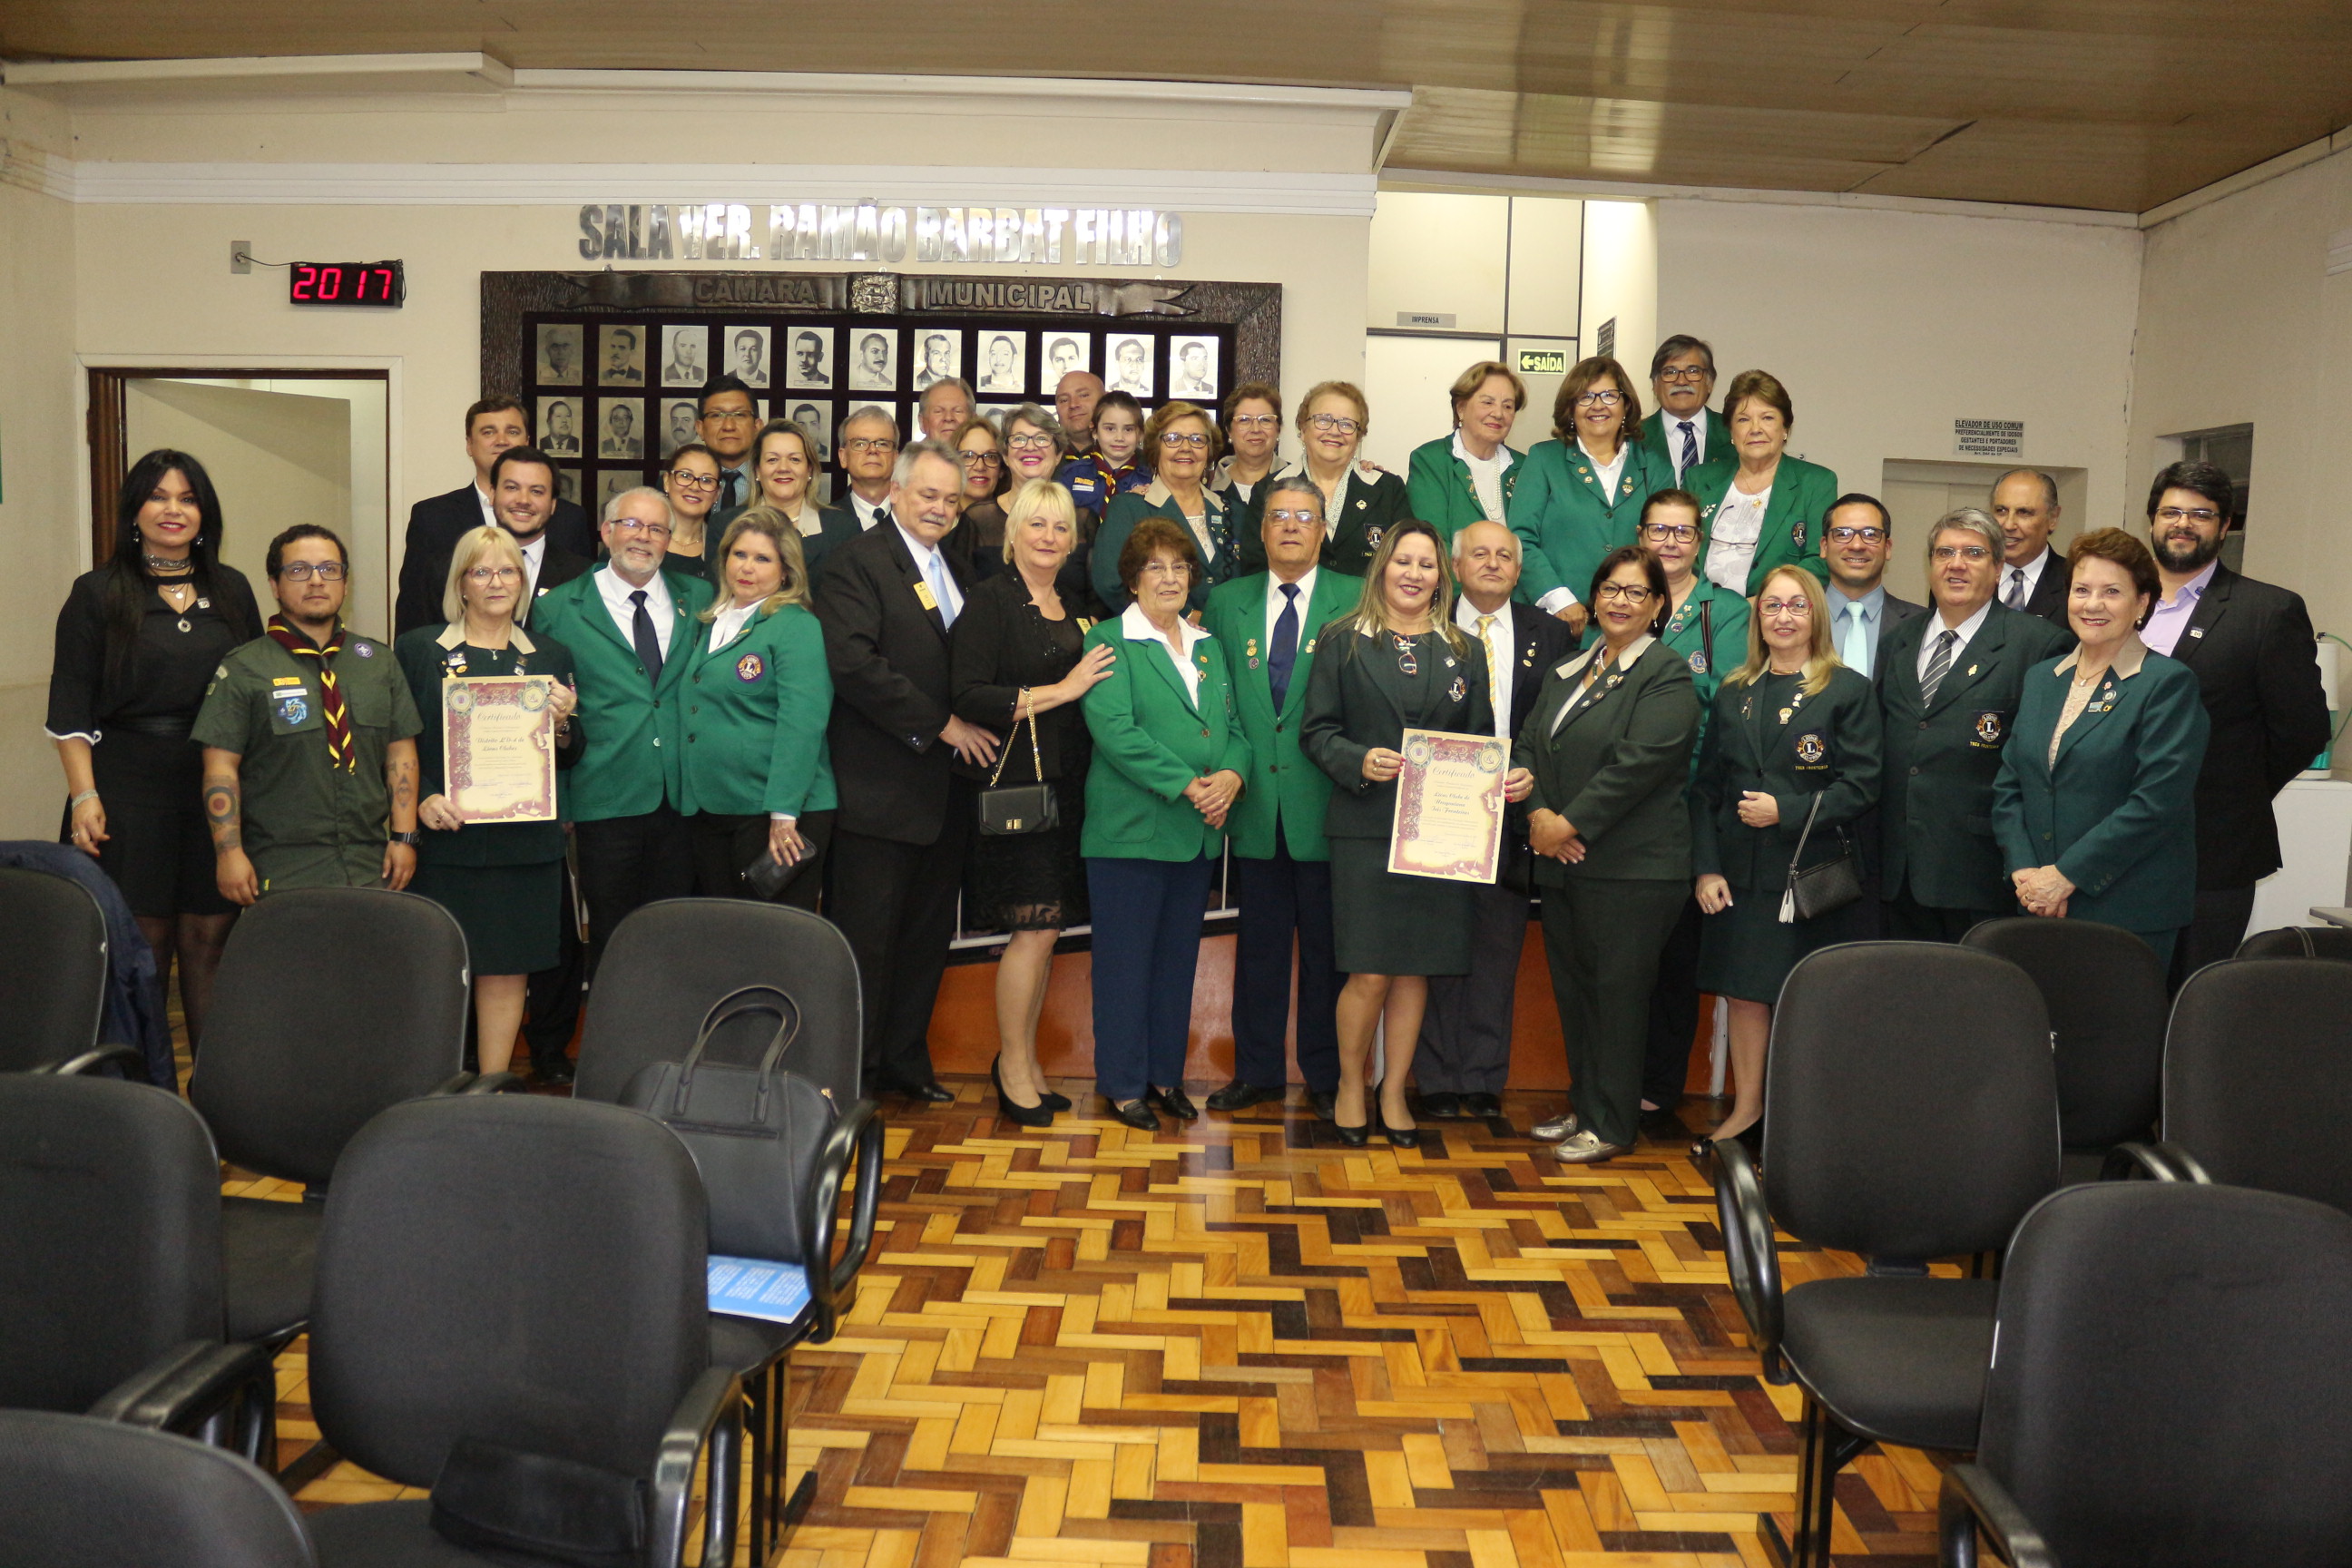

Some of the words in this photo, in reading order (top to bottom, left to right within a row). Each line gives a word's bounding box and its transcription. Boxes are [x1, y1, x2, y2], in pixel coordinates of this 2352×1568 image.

[578, 204, 674, 260] SALA
[679, 203, 760, 260] VER.
[916, 206, 1069, 263] BARBAT
[1075, 209, 1181, 268] FILHO
[929, 282, 1092, 311] MUNICIPAL
[1411, 316, 1440, 324] IMPRENSA
[1534, 352, 1563, 372] SAÍDA
[1955, 419, 1983, 427] ELEVADOR
[1991, 421, 2003, 429] USO
[477, 711, 521, 722] Certificado
[1433, 768, 1475, 779] Certificado
